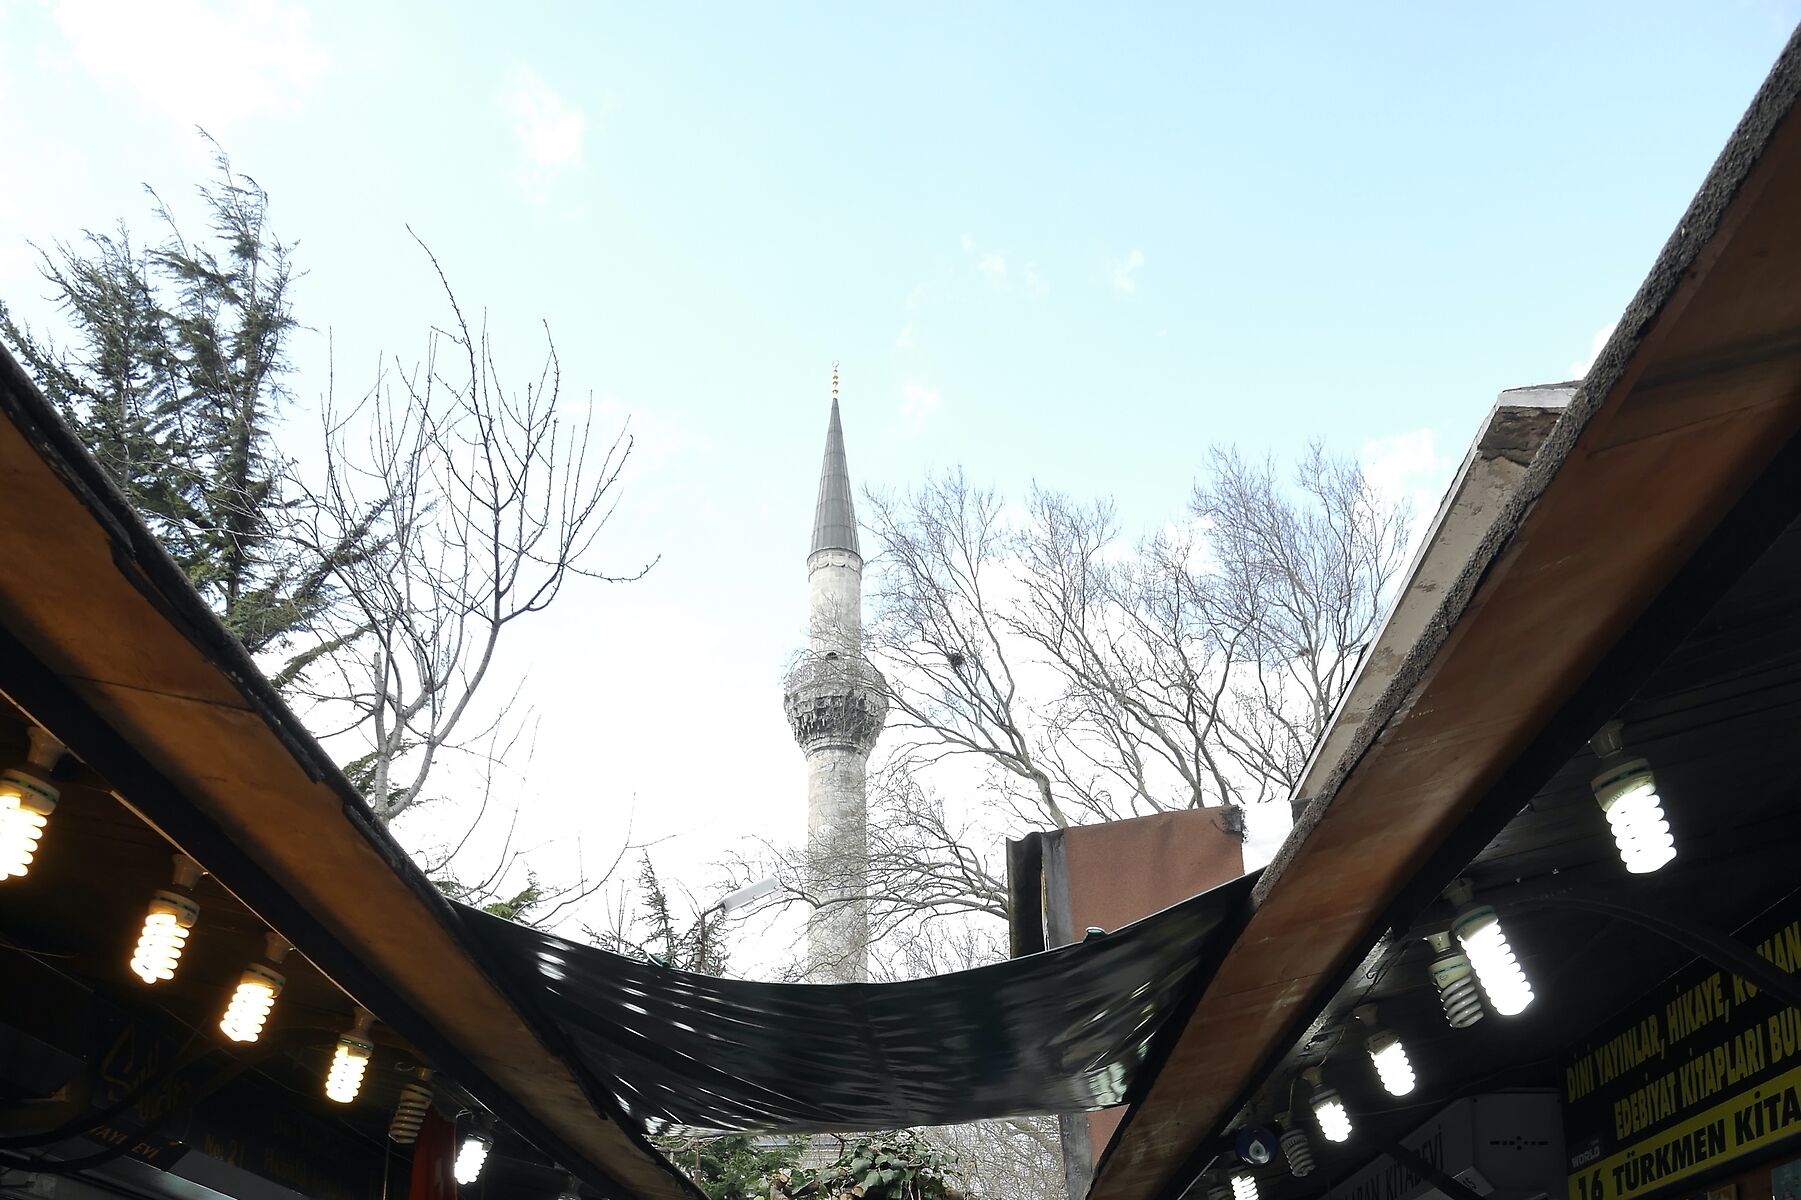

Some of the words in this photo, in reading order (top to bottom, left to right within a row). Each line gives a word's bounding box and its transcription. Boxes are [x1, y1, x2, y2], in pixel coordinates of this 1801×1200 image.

[1614, 1071, 1676, 1141] EDEBİYAT
[1680, 1023, 1767, 1109] KİTAPLARI
[1612, 1118, 1726, 1196] TÜRKMEN
